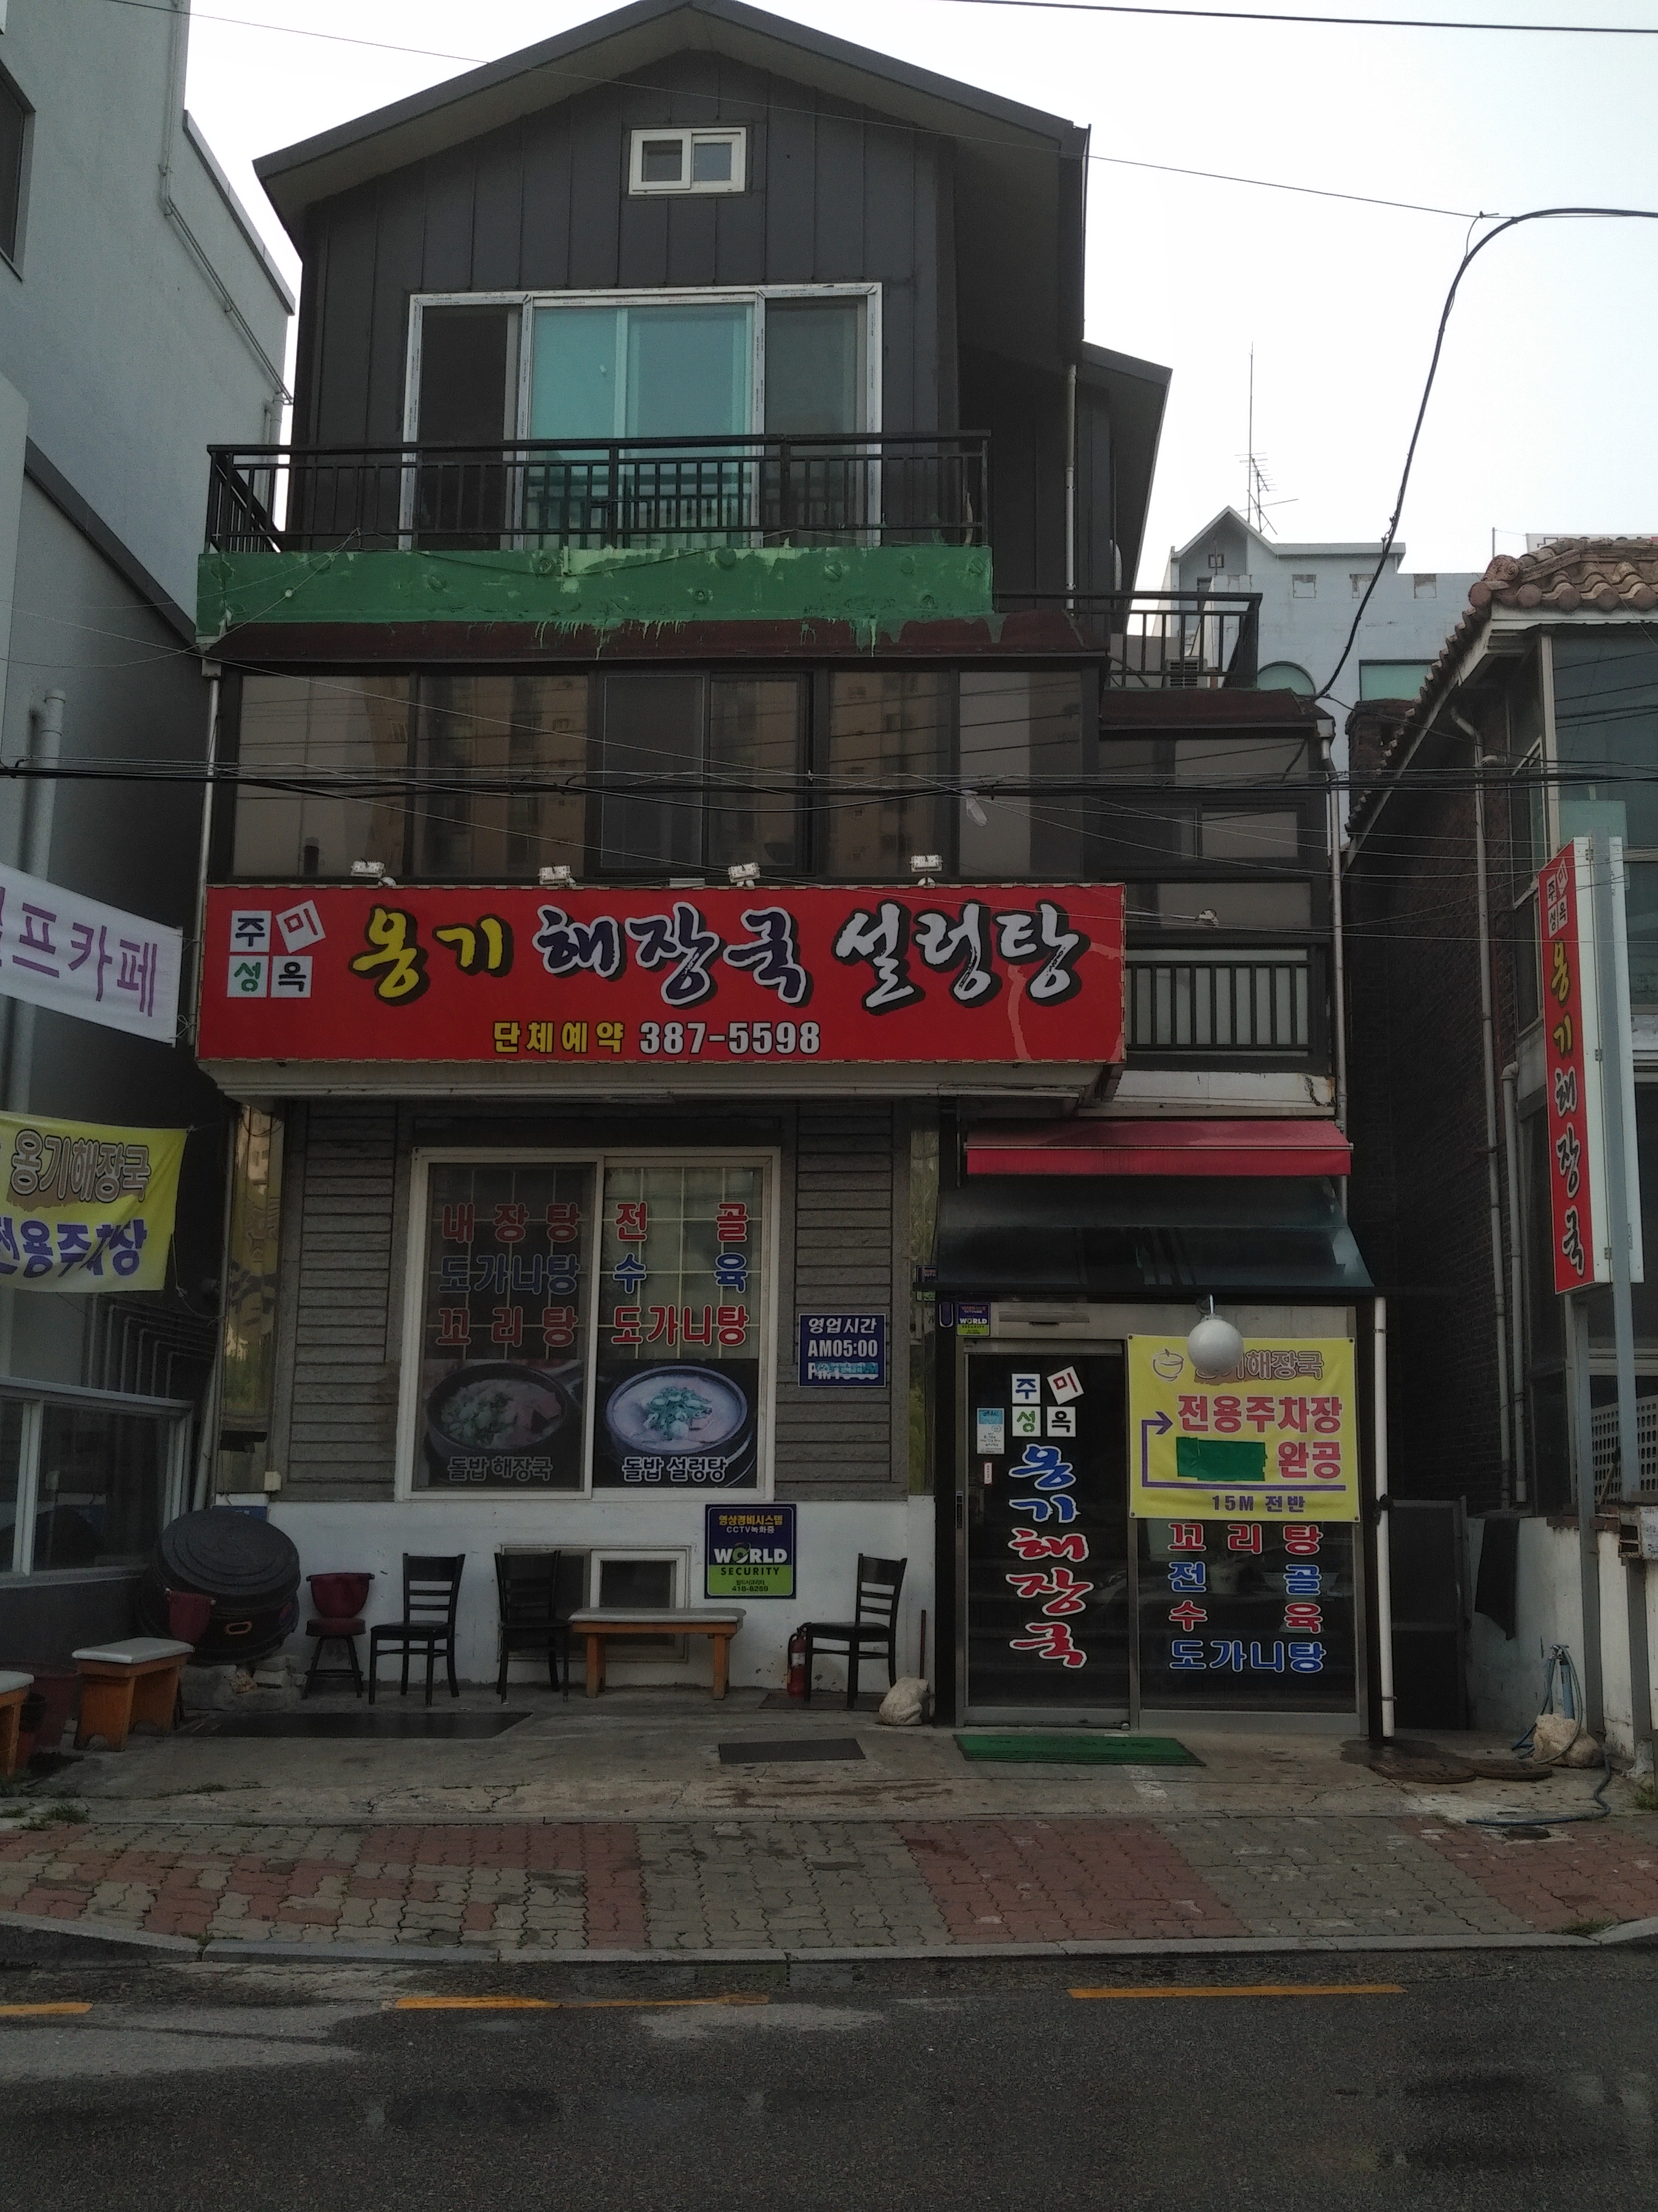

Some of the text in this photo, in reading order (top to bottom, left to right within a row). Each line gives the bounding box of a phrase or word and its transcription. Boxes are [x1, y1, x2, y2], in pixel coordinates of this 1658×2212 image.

[0, 886, 158, 1017] 프카페
[531, 901, 807, 1006] 해장국
[834, 903, 1080, 1008] 설렁탕
[493, 1021, 821, 1055] 단체예약 387-5598
[11, 1129, 152, 1204] 옹기해장국
[442, 1201, 581, 1243] 내장탕
[438, 1253, 580, 1294] 도가니탕
[436, 1305, 578, 1348] 꼬리탕
[611, 1305, 749, 1346] 도가니탕
[808, 1318, 878, 1334] 영업시간
[808, 1339, 878, 1357] AM05:00
[1195, 1349, 1324, 1380] 해장국
[1176, 1394, 1343, 1434] 전용주차장
[492, 1456, 553, 1482] 해장국
[666, 1456, 729, 1482] 설렁탕
[1276, 1440, 1342, 1480] 완공
[718, 1514, 784, 1526] 영상경비시스템
[1212, 1494, 1254, 1512] 15M
[713, 1547, 788, 1564] WORLD
[1168, 1522, 1323, 1555] 꼬리탕
[720, 1567, 780, 1576] SECURITY
[1169, 1639, 1326, 1674] 도가니탕
